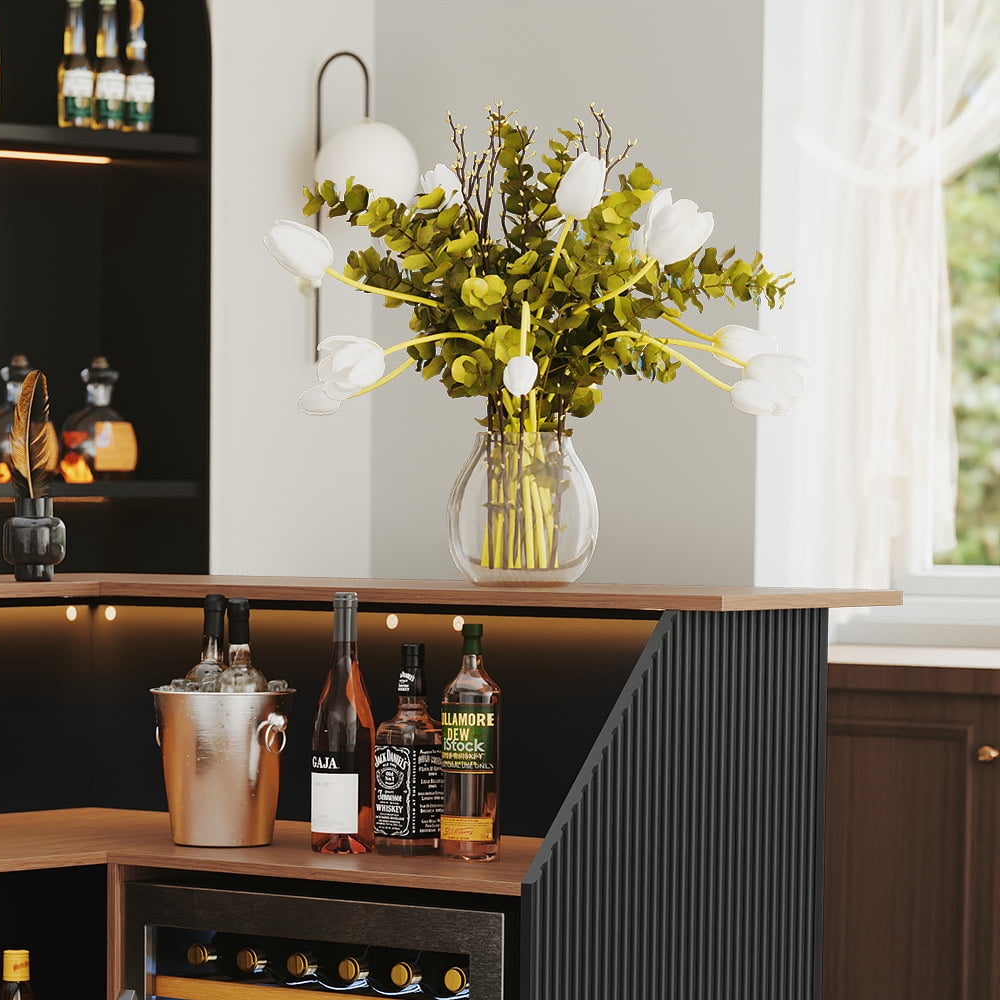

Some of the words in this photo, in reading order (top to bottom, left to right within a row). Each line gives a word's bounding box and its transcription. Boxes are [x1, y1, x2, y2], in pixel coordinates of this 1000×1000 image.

[447, 727, 470, 742] DEW
[443, 737, 486, 752] iStock
[312, 756, 338, 769] GAJA
[376, 803, 403, 813] WHISKEY
